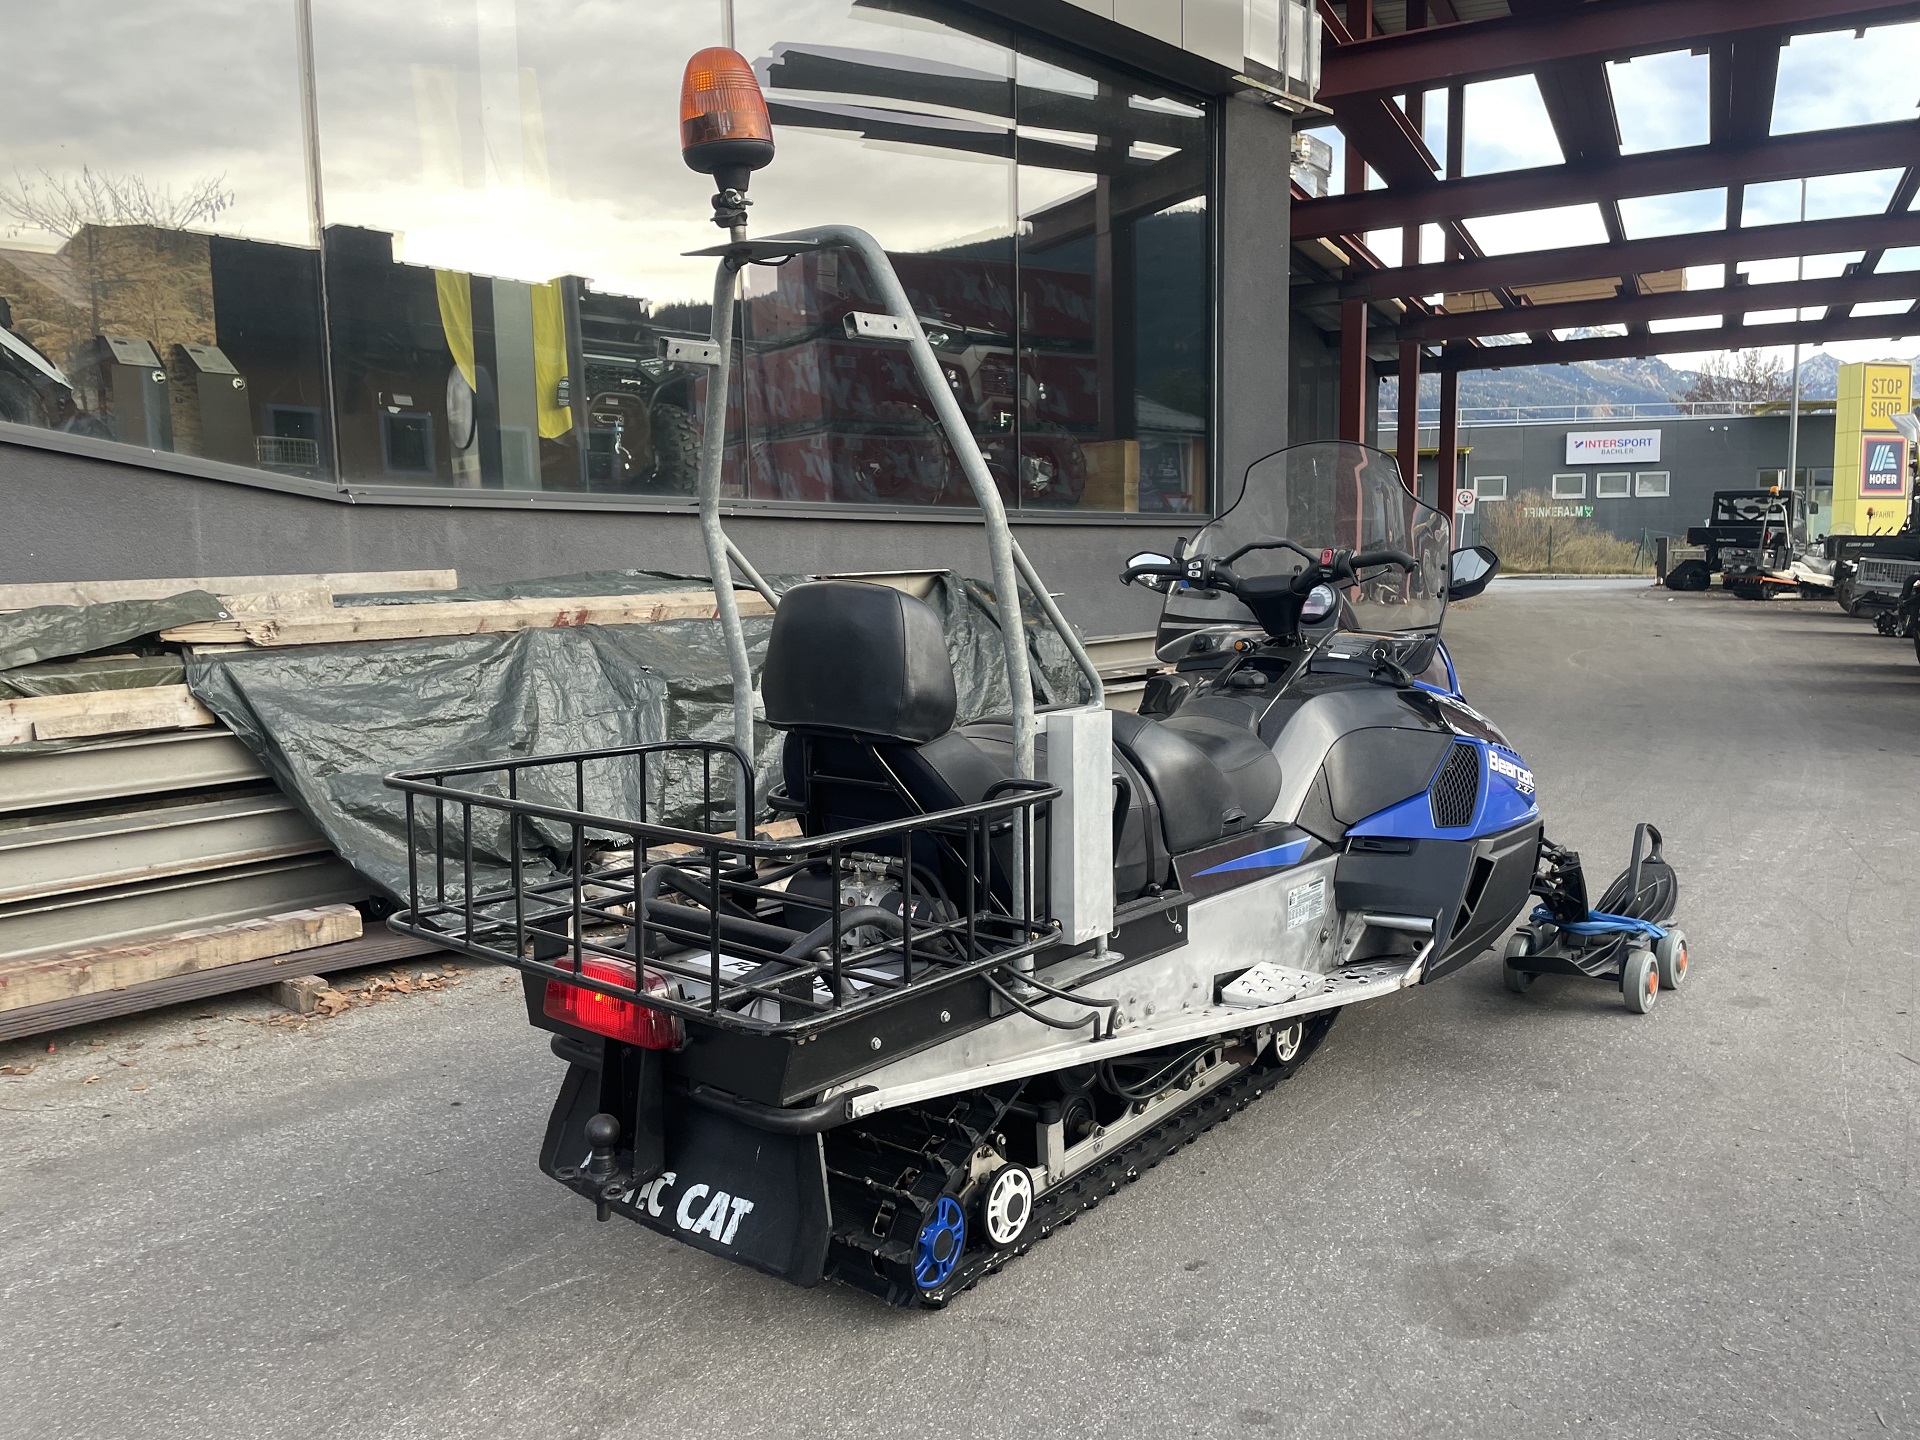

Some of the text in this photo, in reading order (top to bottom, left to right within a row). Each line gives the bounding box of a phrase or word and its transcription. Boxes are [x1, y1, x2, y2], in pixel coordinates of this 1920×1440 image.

[1871, 378, 1903, 394] STOP
[1870, 401, 1902, 417] SHOP
[1585, 438, 1653, 448] INTERSPORT
[1869, 473, 1898, 485] HOFER
[1488, 750, 1535, 786] Bearcat
[1516, 782, 1535, 795] XT
[676, 1183, 755, 1245] CAT
